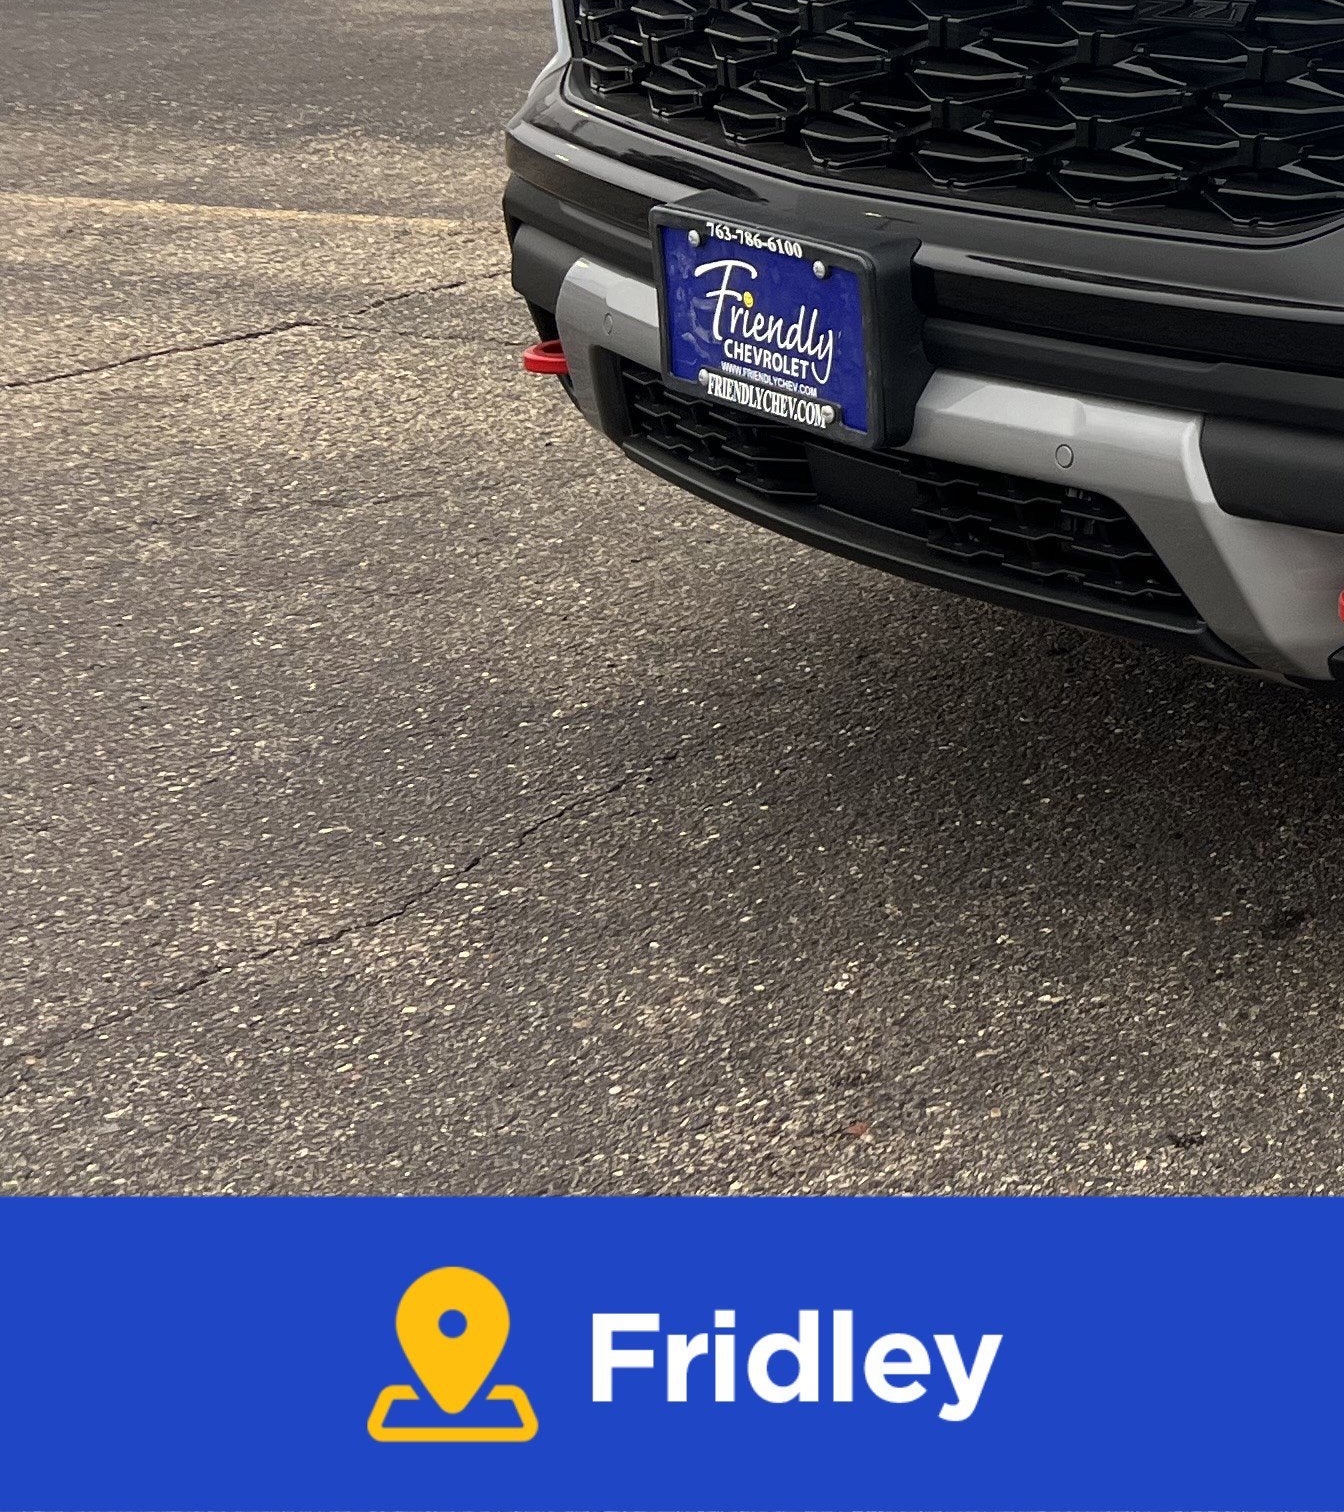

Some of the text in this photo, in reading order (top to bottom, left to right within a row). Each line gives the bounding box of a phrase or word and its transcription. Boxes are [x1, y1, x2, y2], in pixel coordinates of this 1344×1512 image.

[705, 221, 803, 259] 763-786-6100
[694, 259, 834, 384] Friendly
[720, 360, 818, 398] WWW.FRIENDLYCHEV.COM
[723, 338, 810, 380] CHEVROLET
[706, 372, 827, 429] FRIENDLYCHEV.COM
